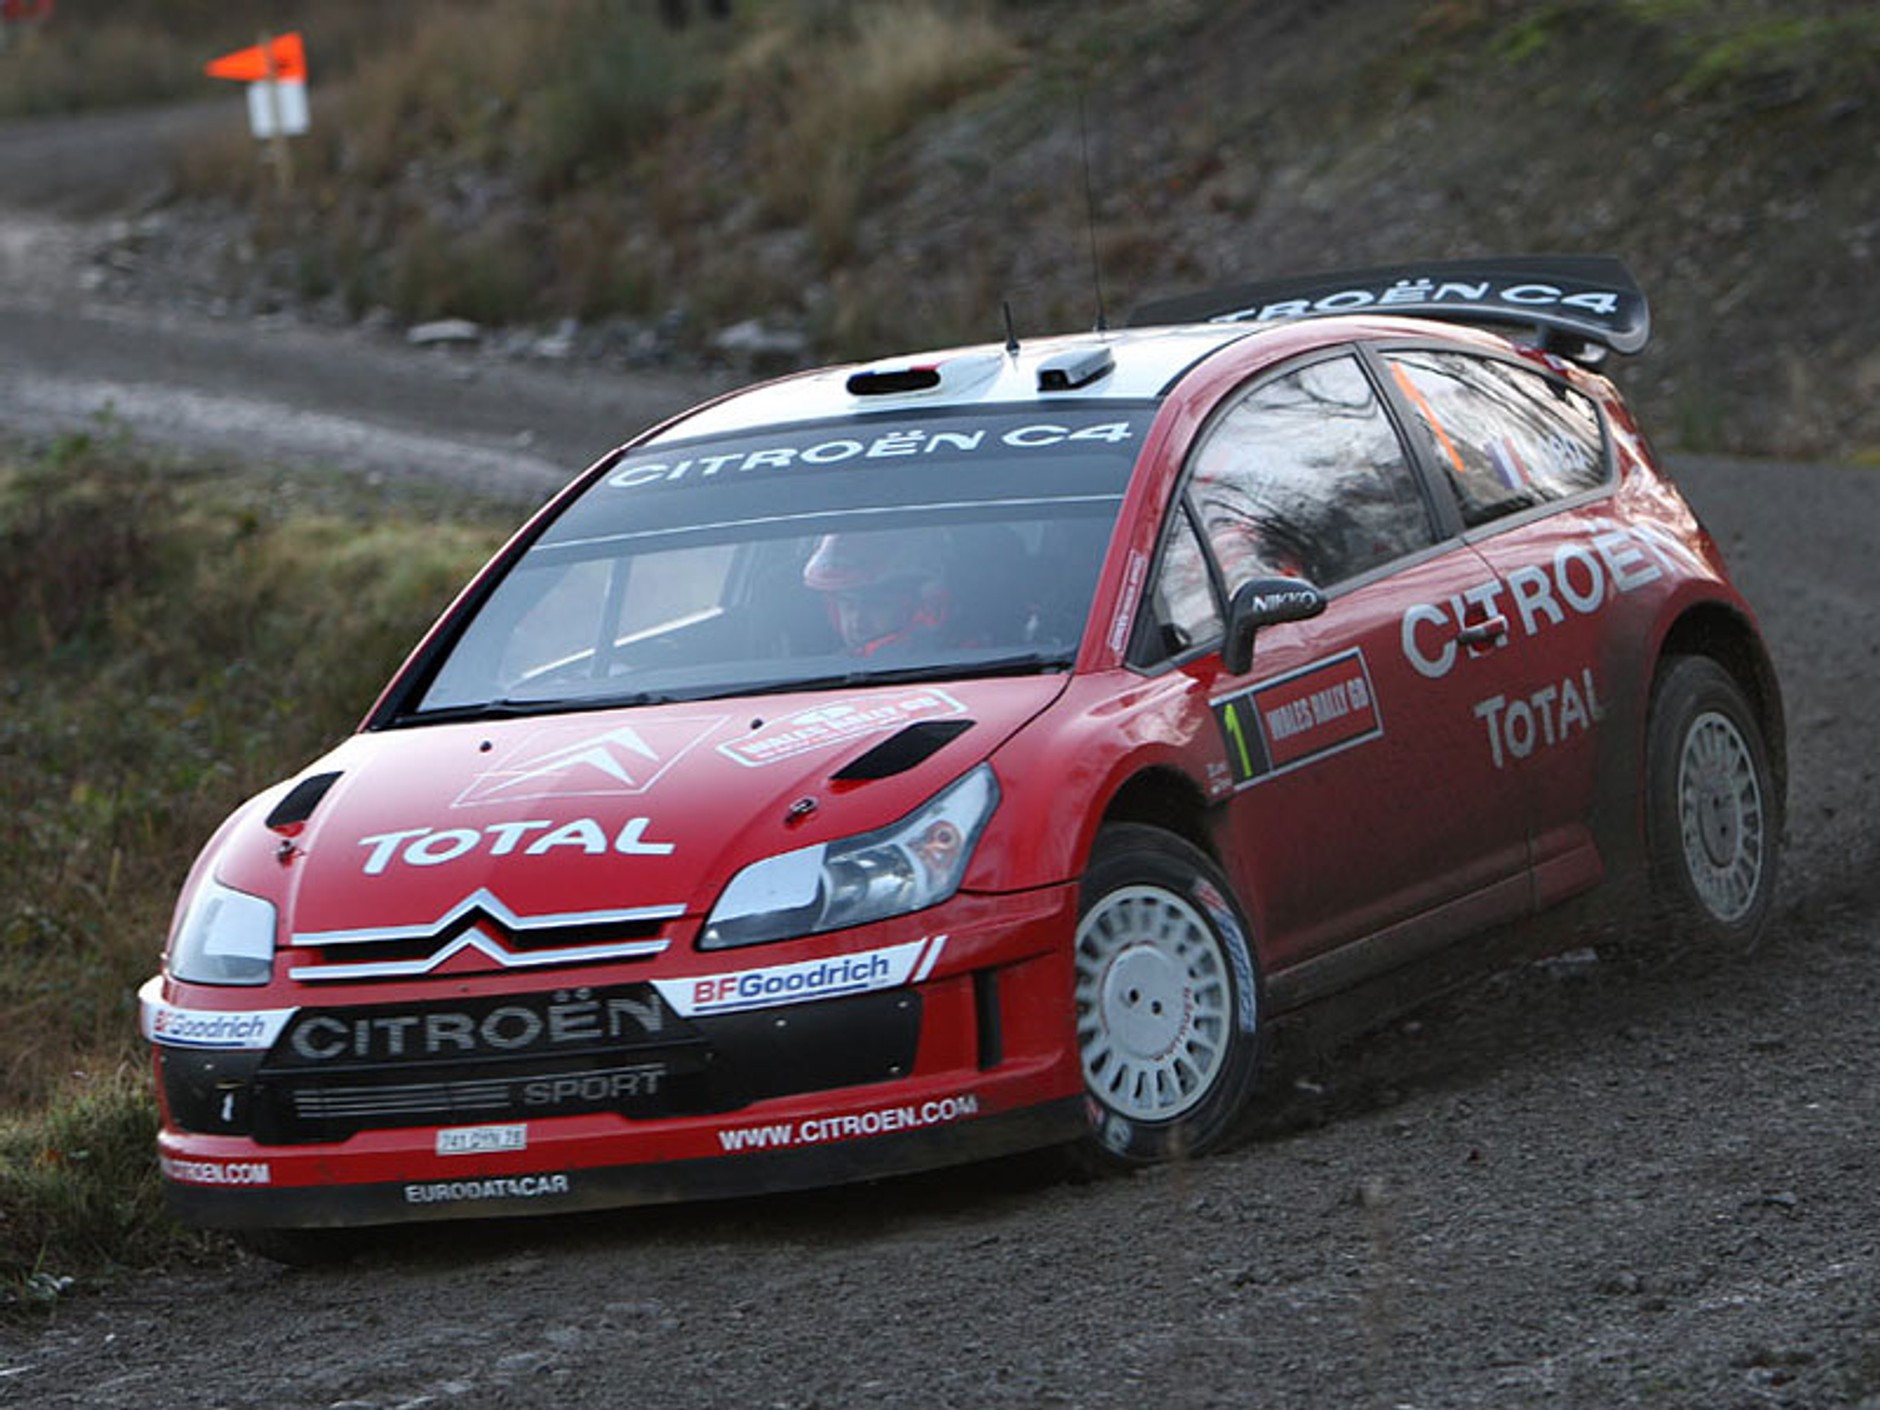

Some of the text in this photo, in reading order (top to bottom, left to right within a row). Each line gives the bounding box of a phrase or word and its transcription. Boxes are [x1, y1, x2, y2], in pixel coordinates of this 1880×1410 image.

[1501, 284, 1619, 315] C4
[607, 421, 1134, 488] CITROËN C4
[1224, 702, 1253, 777] 1
[1473, 668, 1605, 769] TOTAL
[358, 817, 676, 875] TOTAL
[693, 954, 889, 1003] BFGoodrich
[290, 987, 665, 1060] CITROËN
[523, 1068, 667, 1106] SPORT
[718, 1094, 978, 1151] WWW.CITROEN.COM
